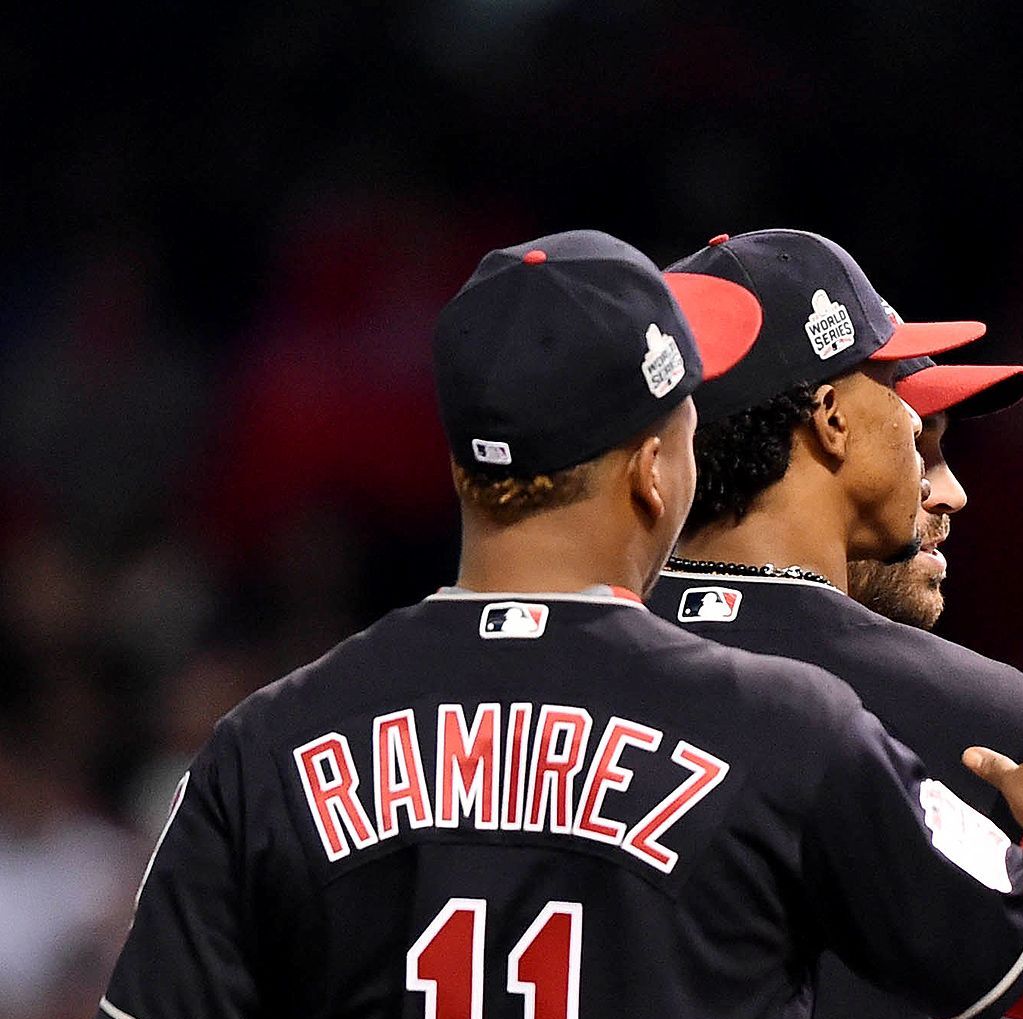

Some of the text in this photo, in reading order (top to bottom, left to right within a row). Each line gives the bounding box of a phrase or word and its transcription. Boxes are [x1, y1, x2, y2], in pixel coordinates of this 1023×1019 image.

[809, 310, 847, 336] WORLD
[814, 321, 852, 351] SERIES
[293, 702, 731, 874] RAMIREZ
